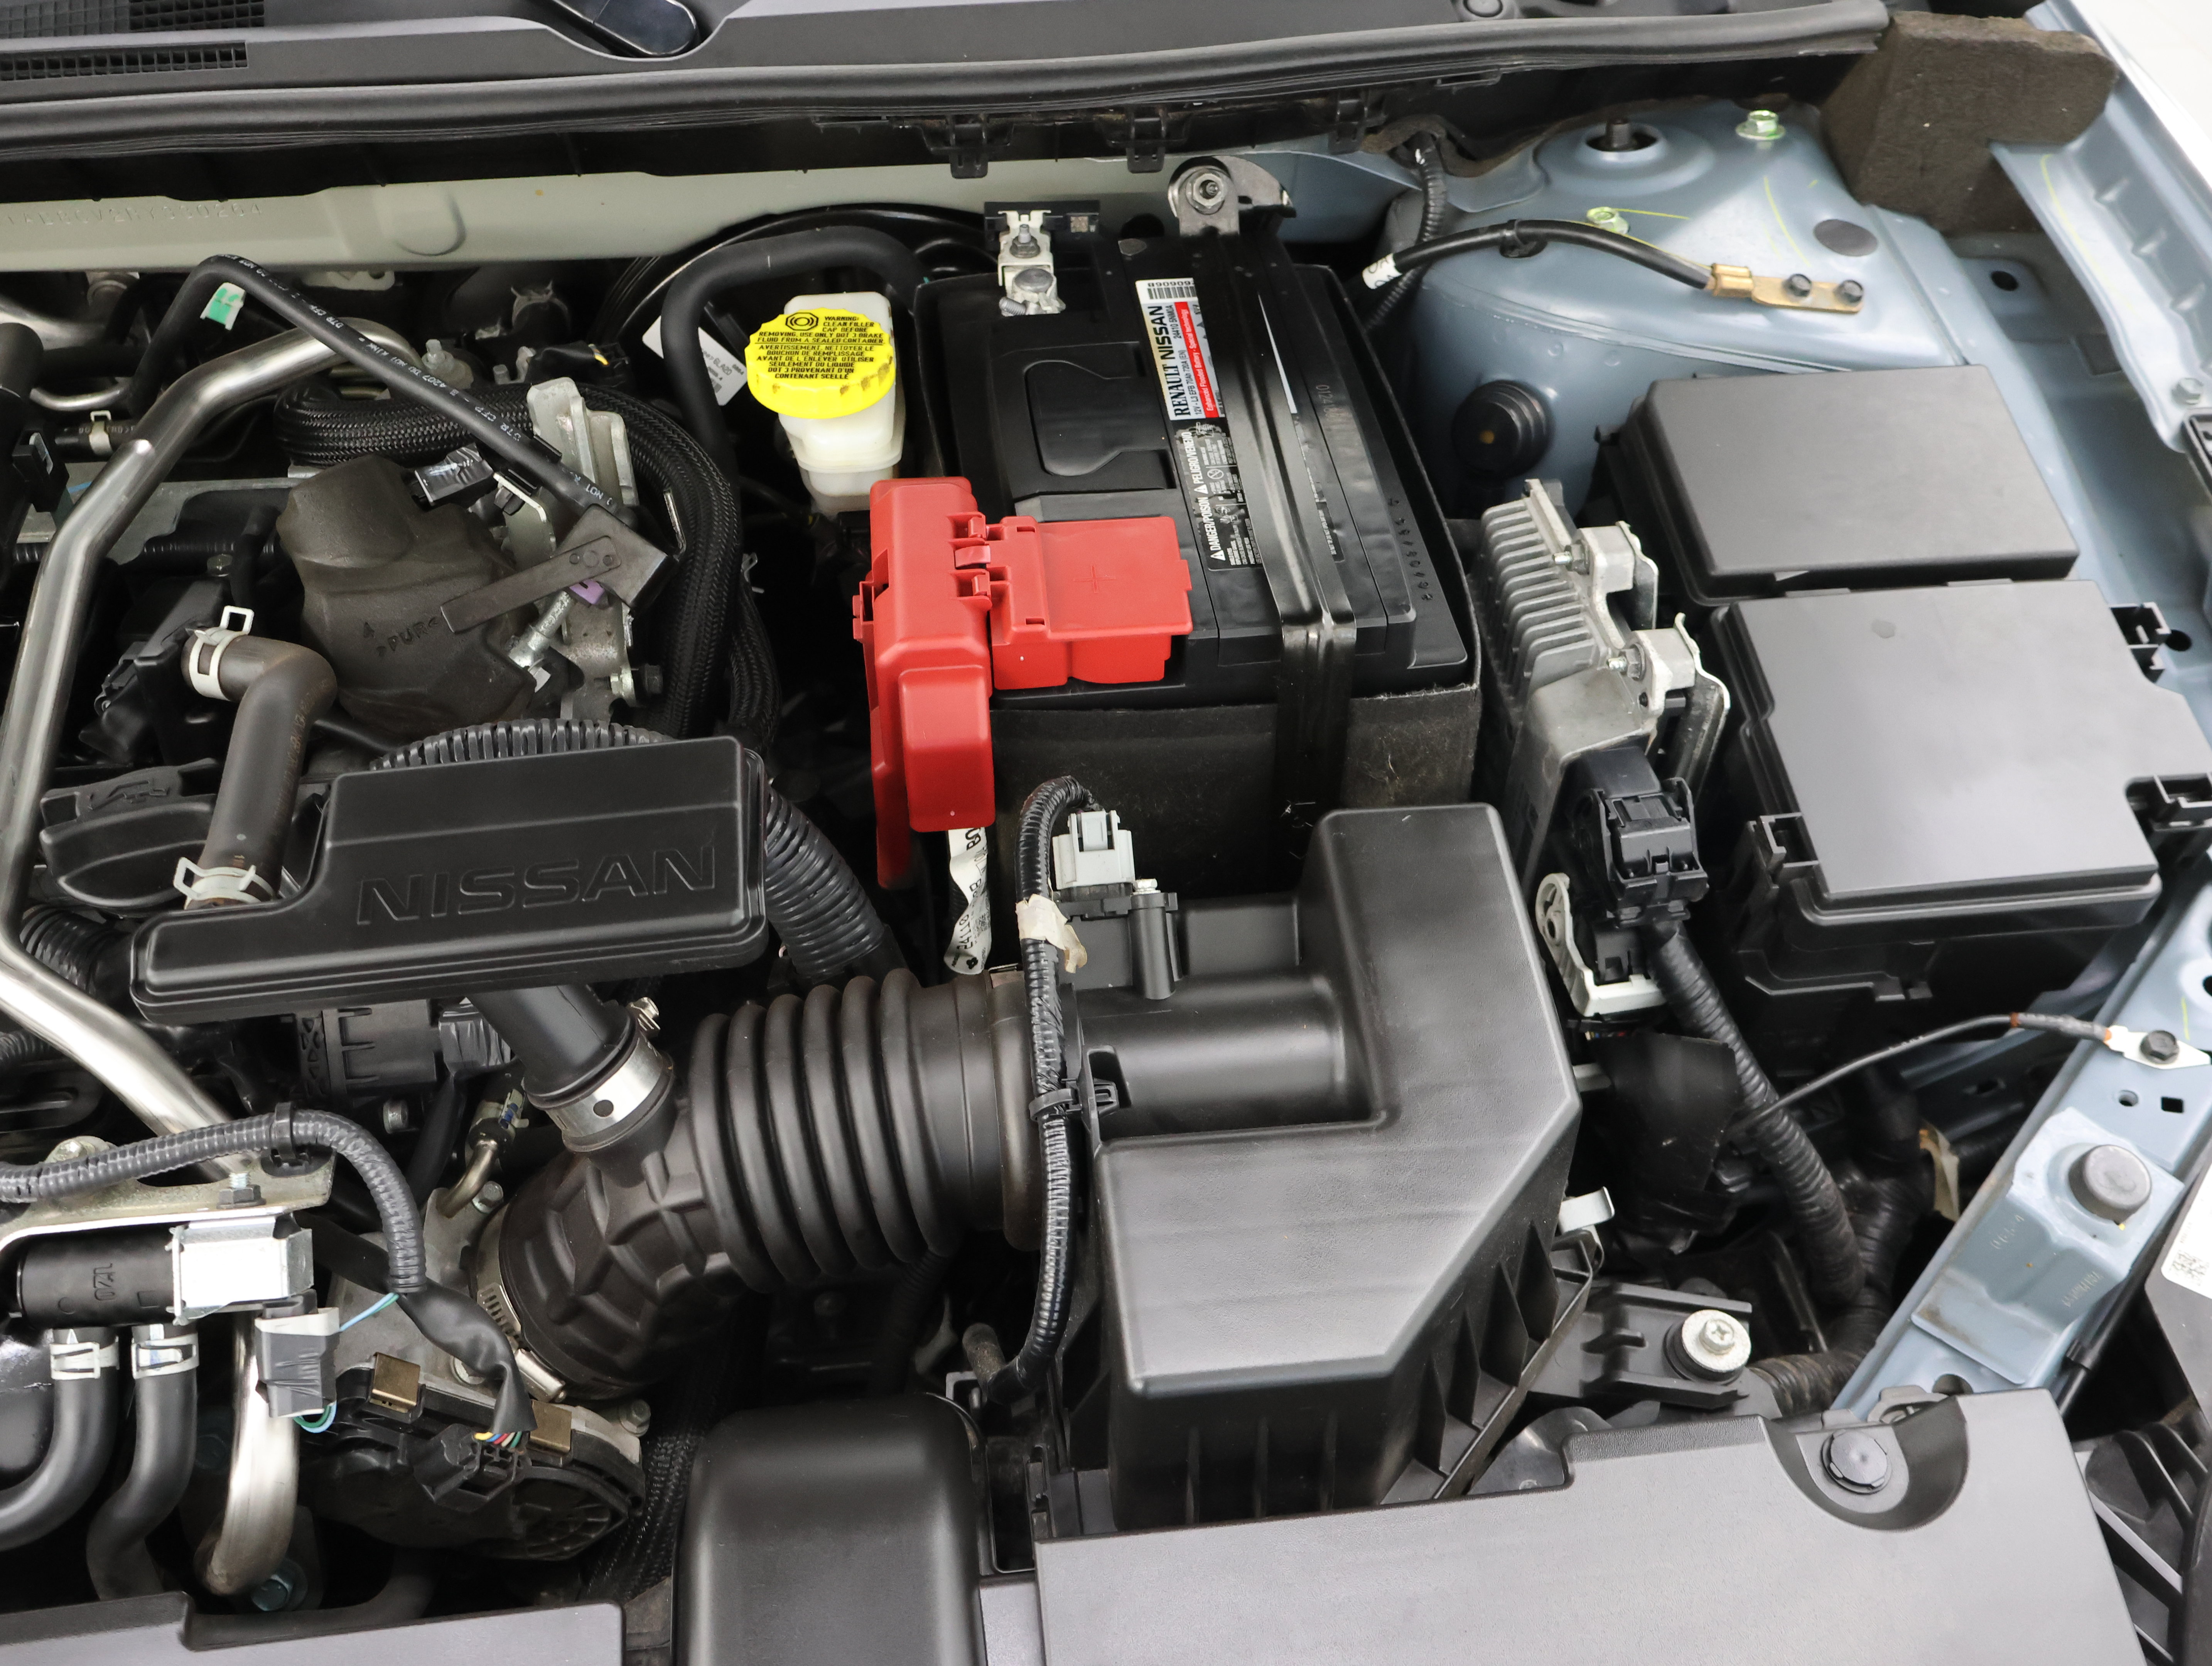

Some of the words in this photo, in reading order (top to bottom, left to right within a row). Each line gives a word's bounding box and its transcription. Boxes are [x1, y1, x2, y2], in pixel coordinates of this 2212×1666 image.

[1179, 309, 1193, 332] technology
[1147, 305, 1175, 359] NISSAN
[1170, 324, 1182, 339] 24410
[1186, 333, 1198, 348] Special
[1177, 349, 1188, 359] (EN)
[1191, 352, 1203, 368] Battery
[1180, 361, 1190, 372] 720A
[1196, 369, 1207, 387] Flooded
[1162, 363, 1191, 416] RENAULT
[1187, 385, 1196, 395] EFB
[1202, 388, 1214, 411] Enhanced
[1193, 406, 1202, 414] 12V
[1180, 430, 1205, 484] PELIGRO/VENENO
[1197, 496, 1222, 550] DANGER/POISON
[356, 847, 716, 925] NISSAN
